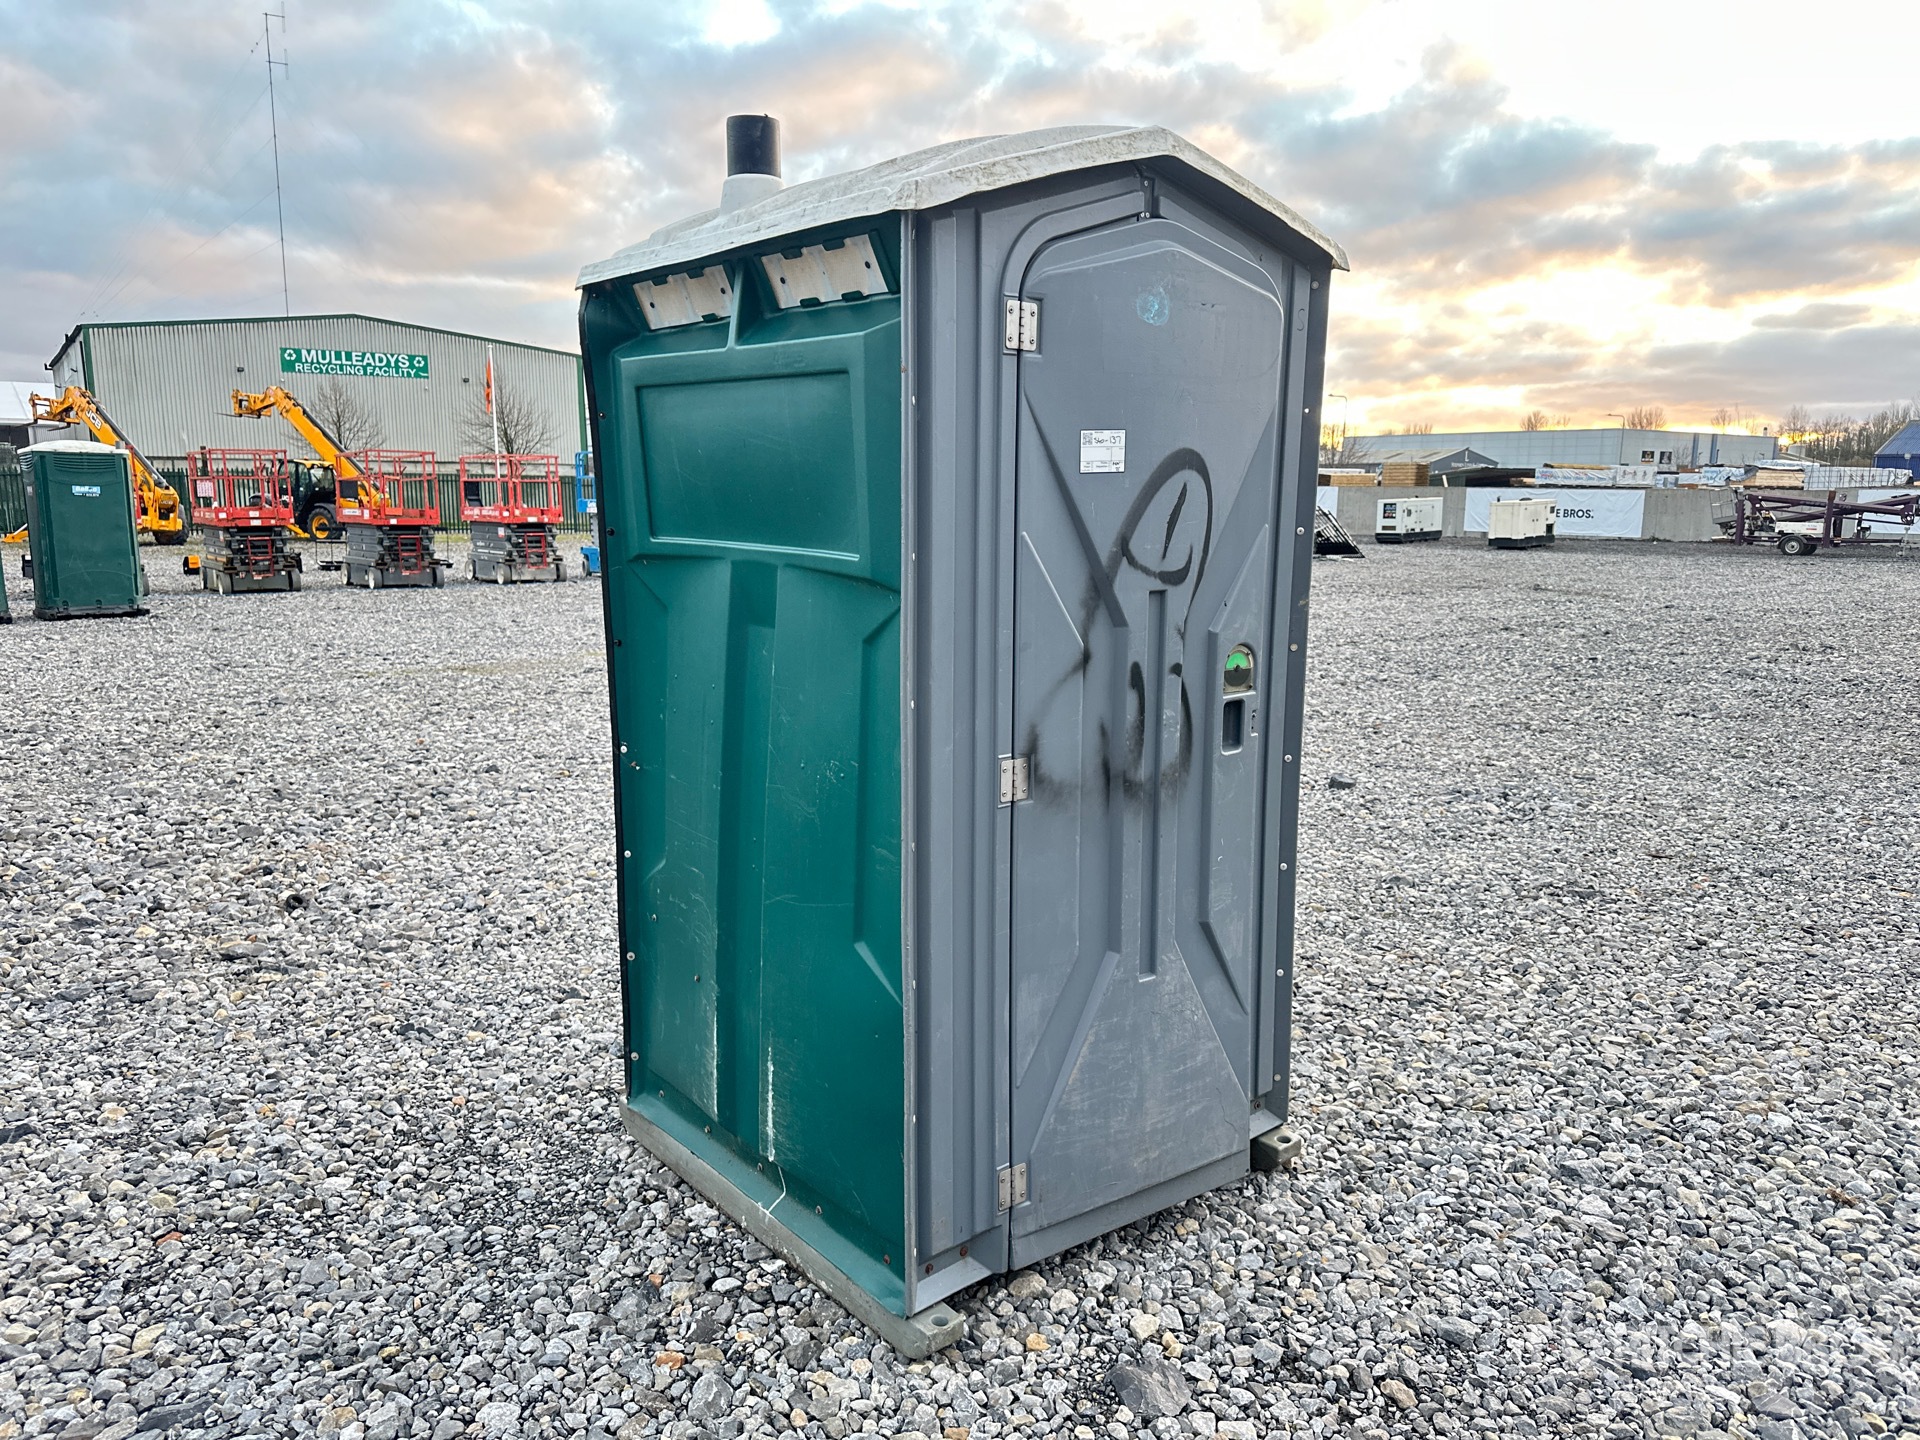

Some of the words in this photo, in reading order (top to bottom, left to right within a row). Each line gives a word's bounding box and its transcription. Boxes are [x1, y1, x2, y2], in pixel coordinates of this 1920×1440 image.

[301, 349, 410, 368] MULLEADYS
[295, 362, 364, 376] RECYCLING
[367, 365, 417, 378] FACILITY
[85, 409, 103, 430] JCB
